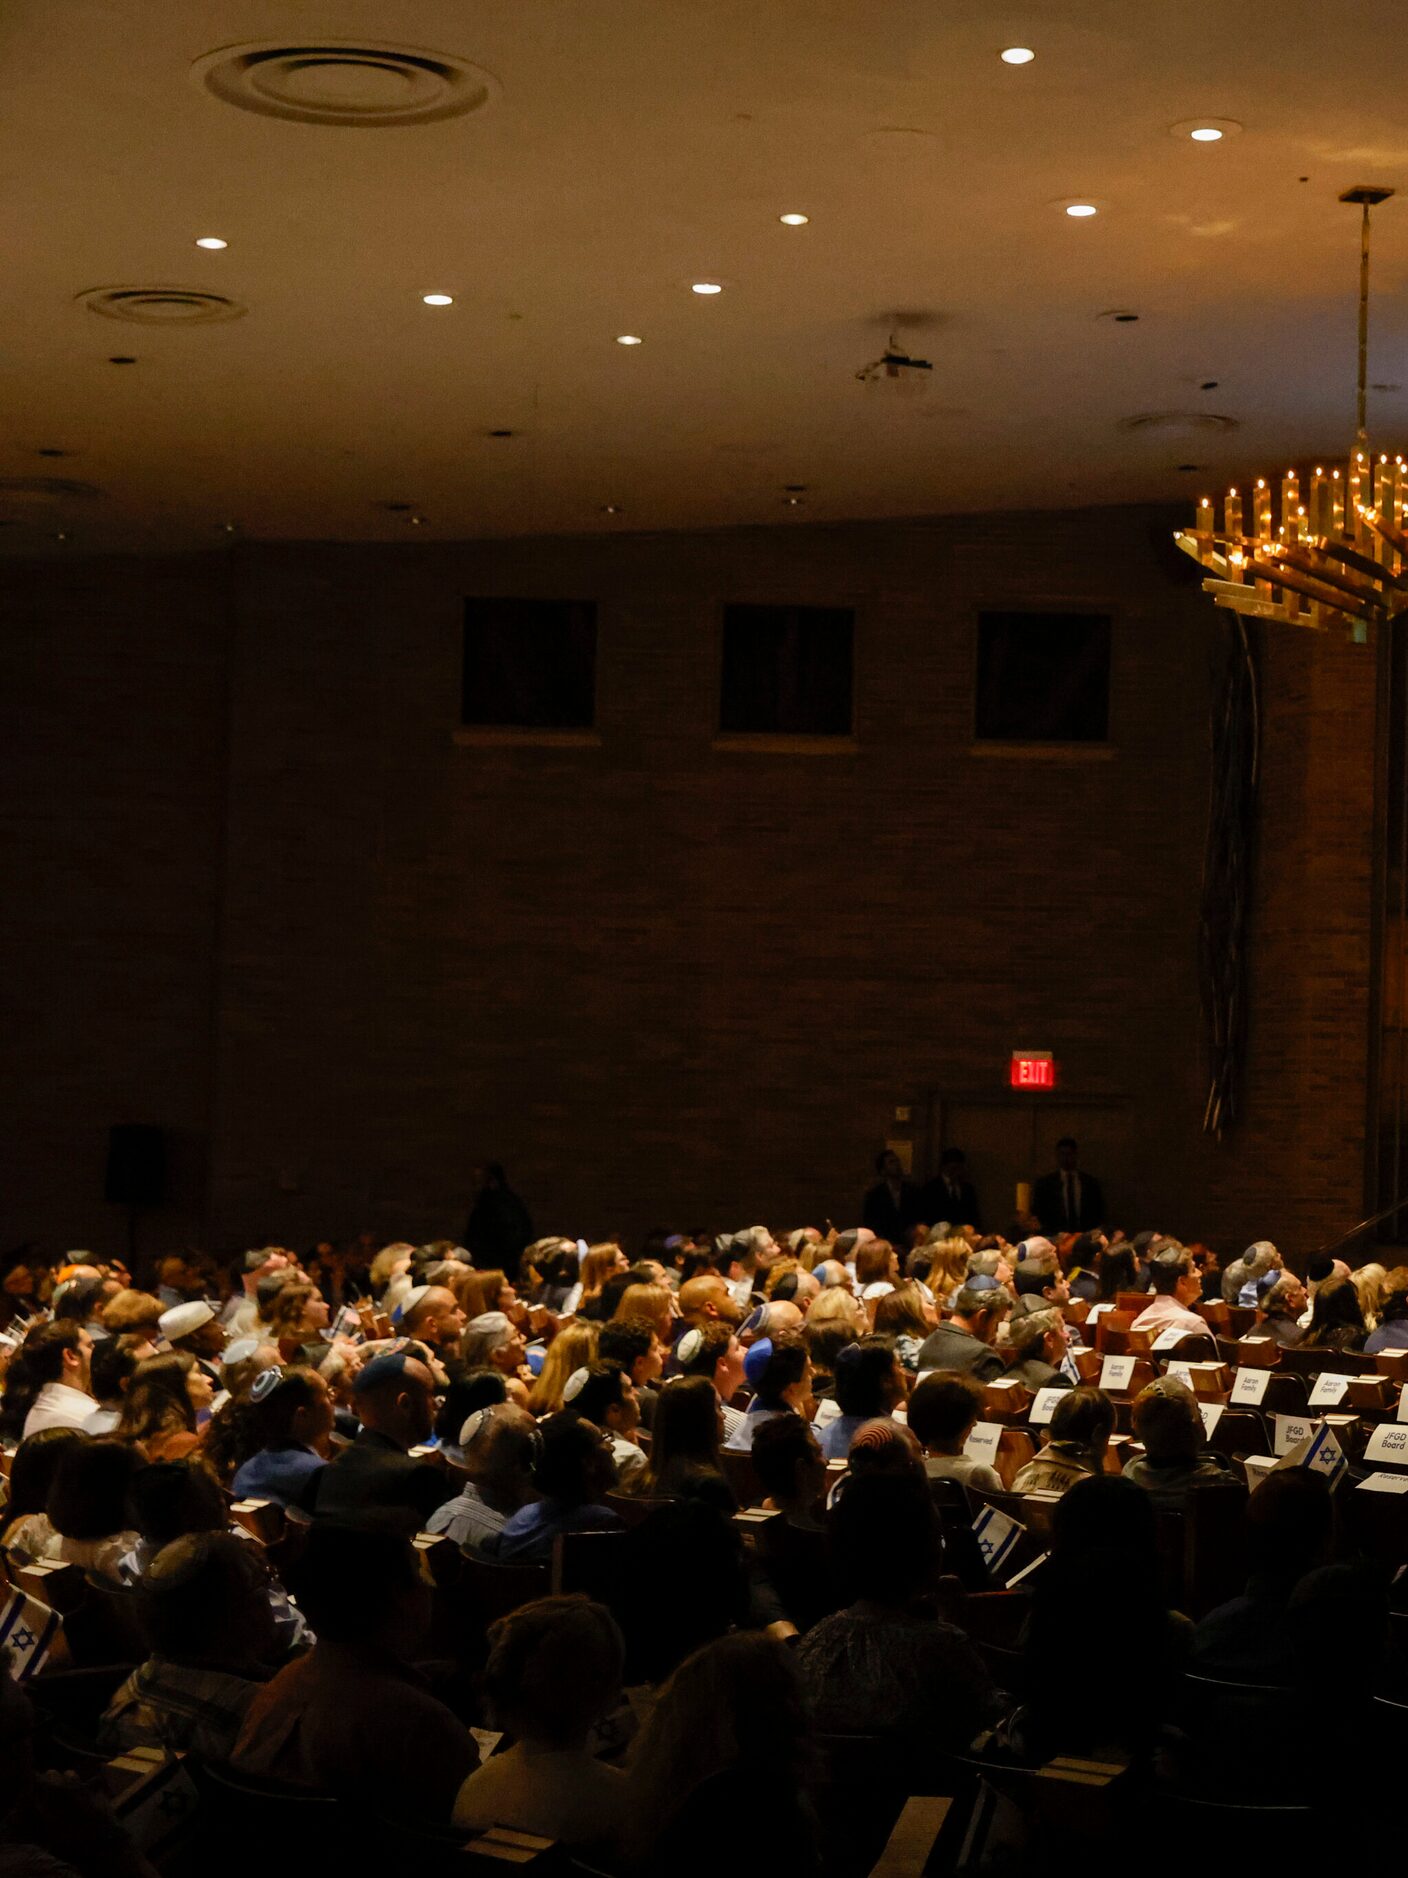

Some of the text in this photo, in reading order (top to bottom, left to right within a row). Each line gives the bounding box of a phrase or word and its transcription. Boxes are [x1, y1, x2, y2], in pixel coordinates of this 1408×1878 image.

[1019, 1061, 1048, 1083] EXIT
[1286, 1426, 1304, 1436] JFGD
[1385, 1432, 1407, 1441] JFGD
[1381, 1440, 1406, 1450] Board
